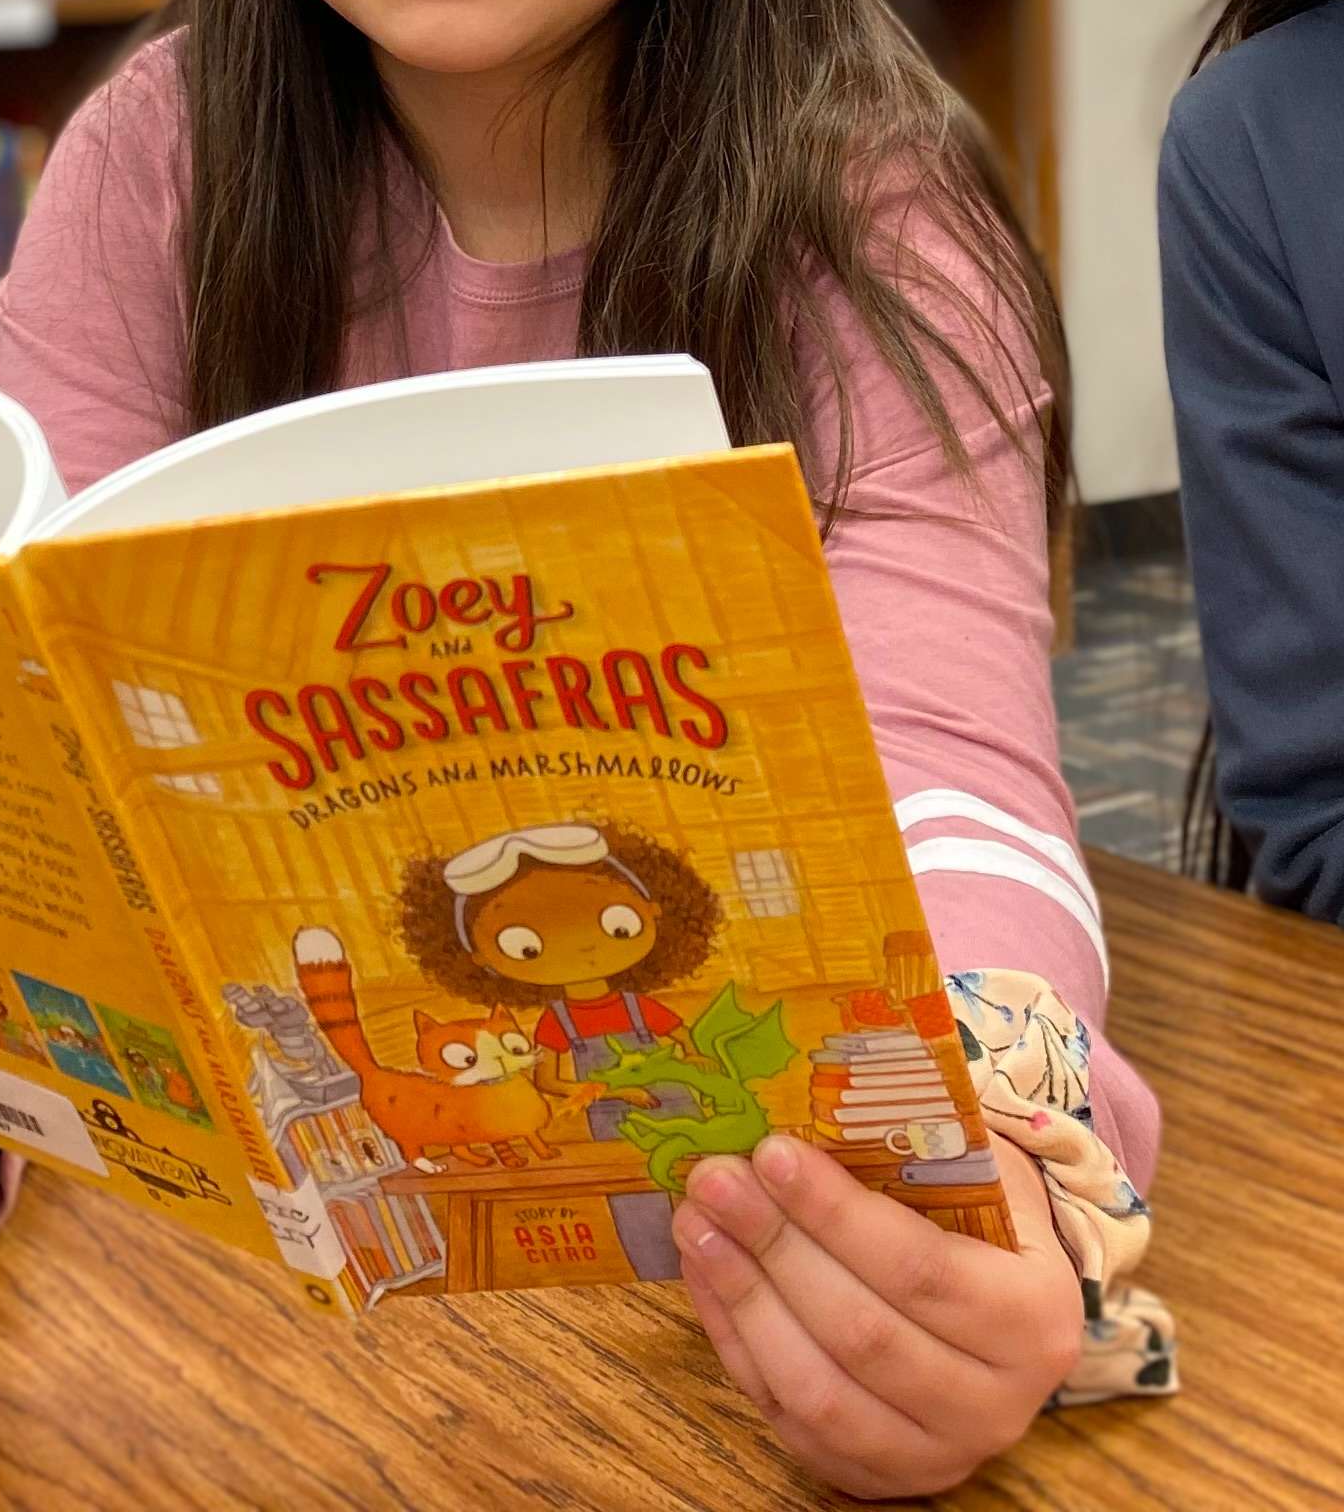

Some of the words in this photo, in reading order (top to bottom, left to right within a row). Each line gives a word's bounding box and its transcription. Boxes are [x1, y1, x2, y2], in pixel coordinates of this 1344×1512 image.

[306, 562, 574, 653] Zoey
[244, 643, 729, 790] SASSAFRAS
[287, 770, 420, 830] DRAGONS
[514, 1222, 596, 1249] ASIA
[526, 1245, 598, 1264] CITRO
